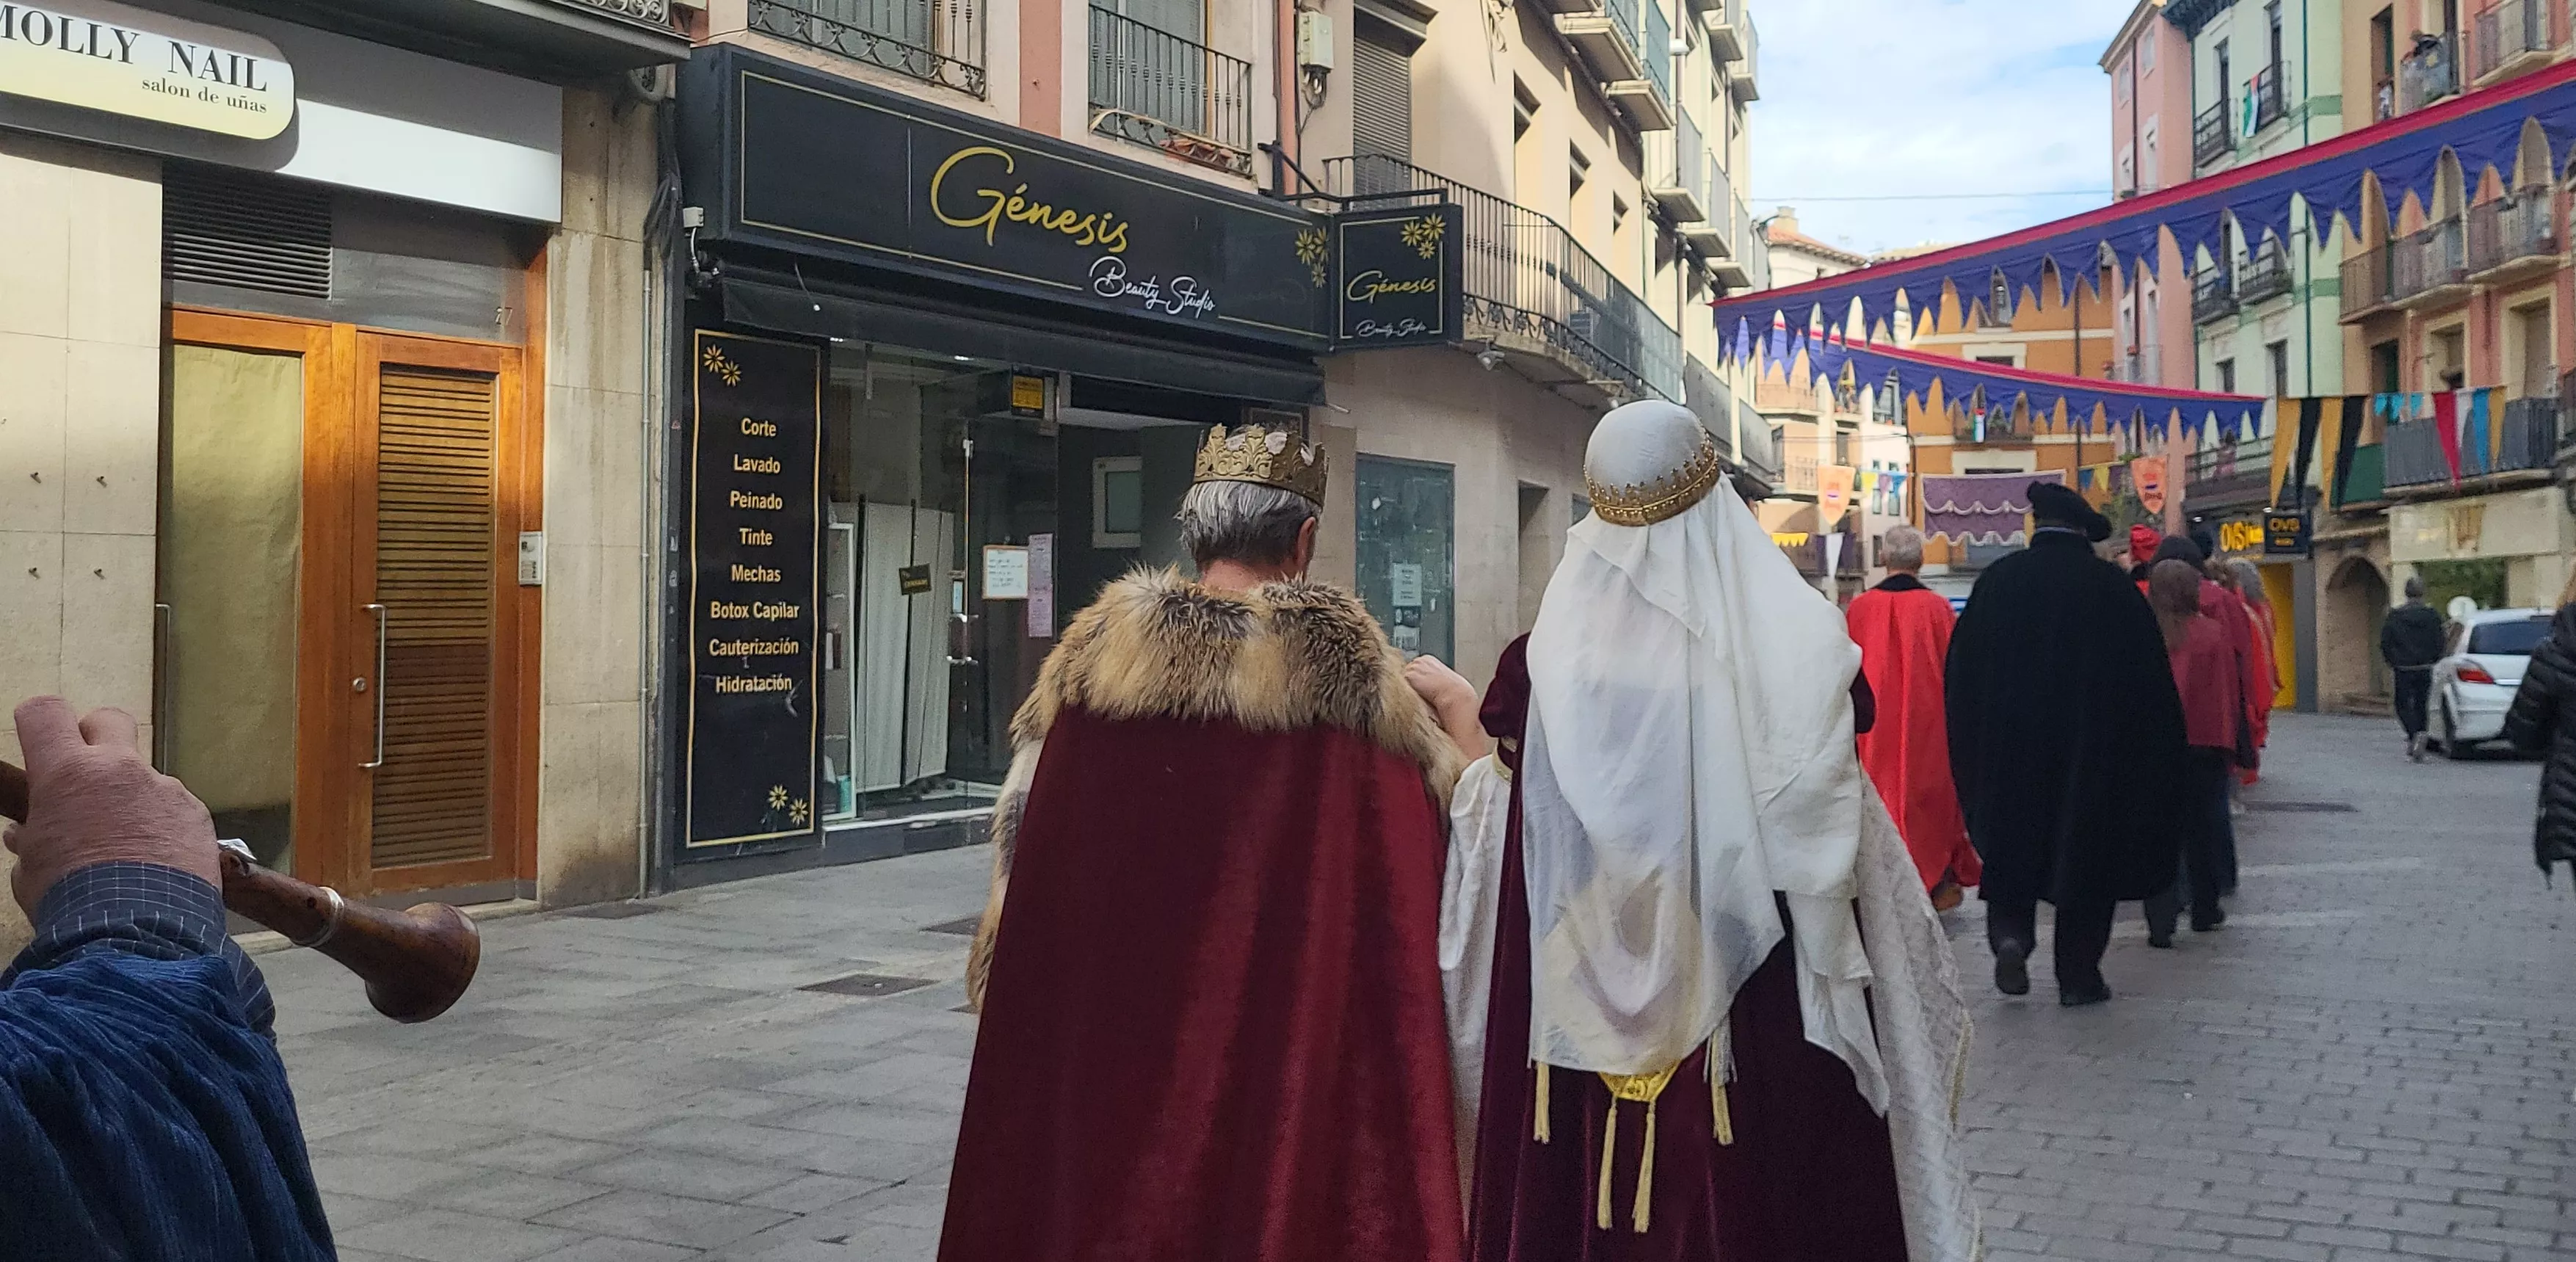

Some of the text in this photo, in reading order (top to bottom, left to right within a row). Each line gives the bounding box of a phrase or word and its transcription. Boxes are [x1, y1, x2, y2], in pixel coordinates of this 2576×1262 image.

[167, 40, 267, 93] NAIL
[142, 77, 267, 114] salon de uñas
[930, 146, 1128, 253] Génesis
[1089, 255, 1216, 319] Beauty Studio
[1347, 270, 1437, 304] Génesis
[740, 417, 777, 437] Corte
[733, 453, 781, 474] Lavado
[730, 490, 783, 510] Peinado
[739, 527, 773, 545] Tinte
[731, 564, 781, 582] Mechas
[711, 601, 800, 622] Botox Capilar
[709, 637, 799, 656] Cauterización
[715, 672, 793, 693] Hidratación
